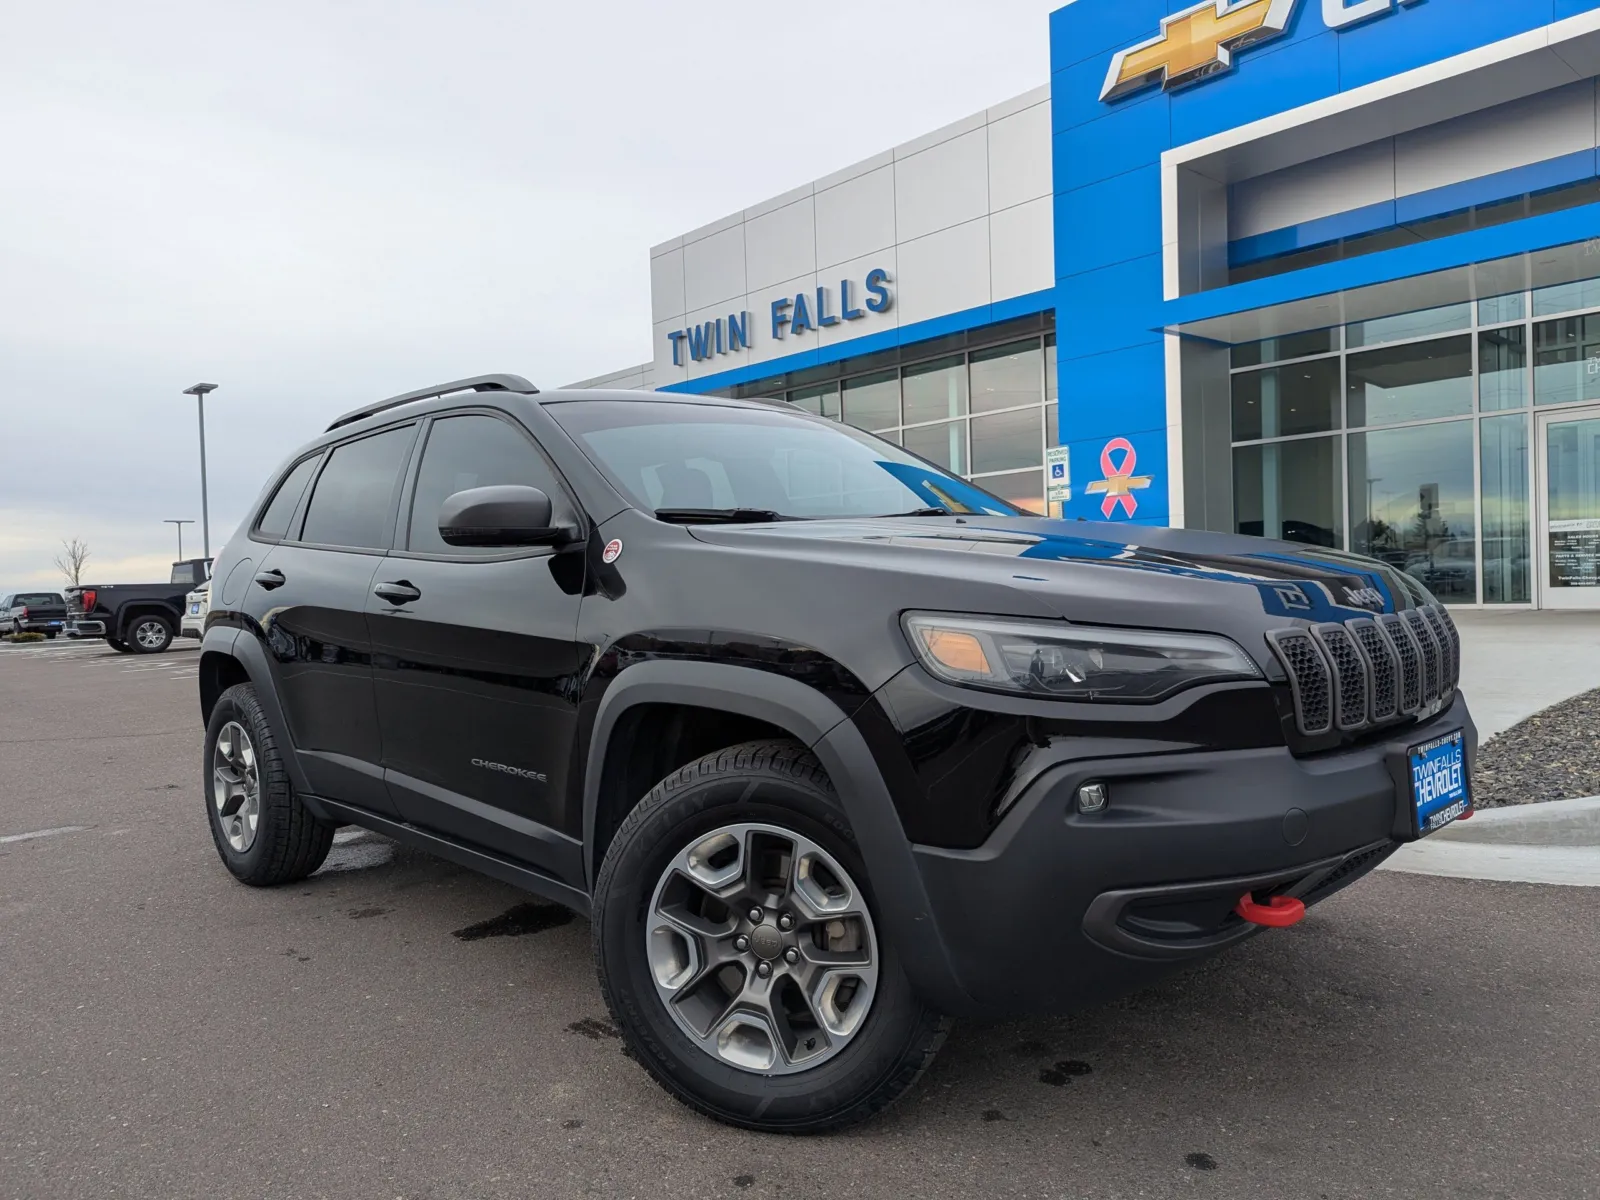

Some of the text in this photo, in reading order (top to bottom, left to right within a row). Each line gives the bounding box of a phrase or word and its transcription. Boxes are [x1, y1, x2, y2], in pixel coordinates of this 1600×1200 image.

[667, 268, 893, 366] TWIN FALLS
[1342, 586, 1386, 607] Jeep
[471, 758, 548, 782] CHEROKEE
[1414, 762, 1462, 807] CHEVROLET
